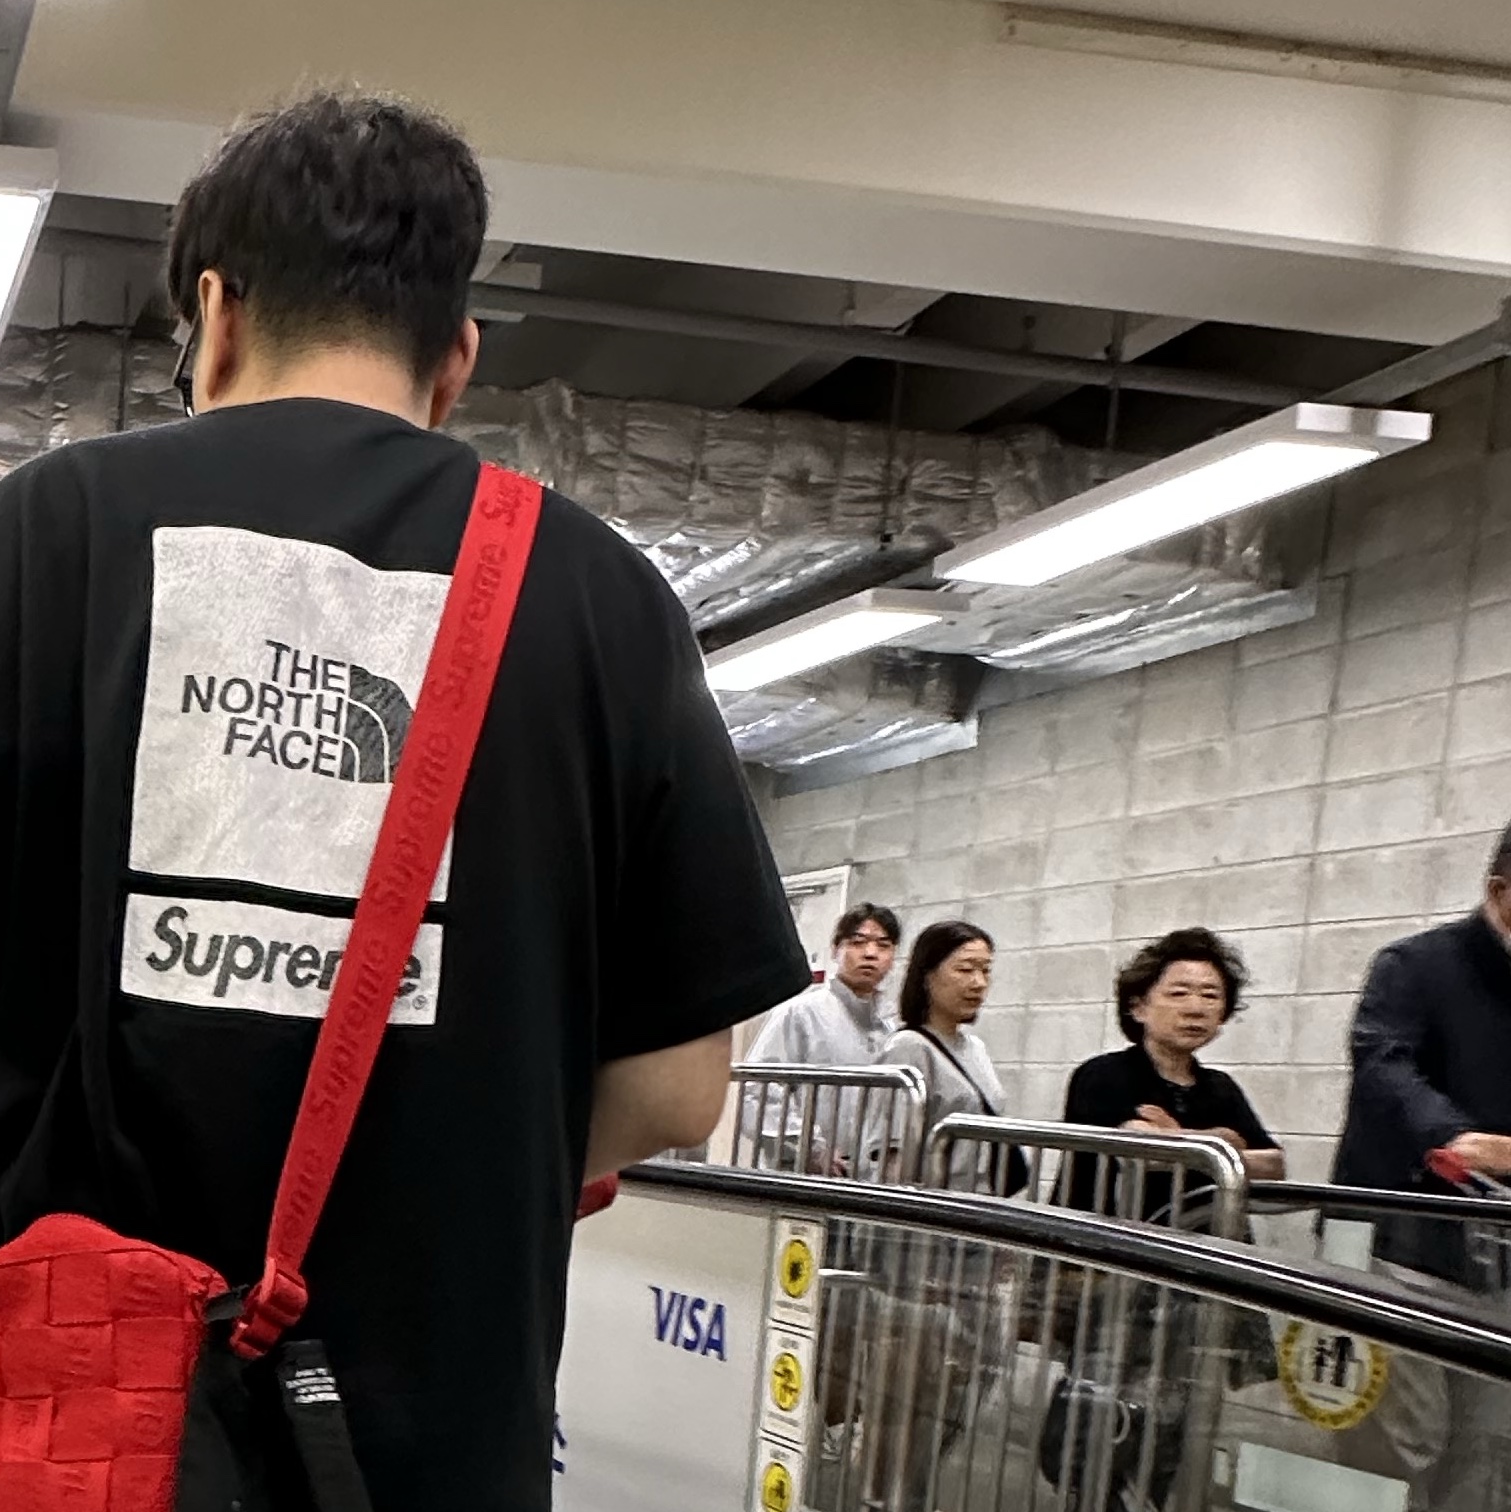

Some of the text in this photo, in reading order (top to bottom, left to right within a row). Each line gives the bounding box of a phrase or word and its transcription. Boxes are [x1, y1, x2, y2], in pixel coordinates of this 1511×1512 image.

[265, 639, 346, 694] THE
[181, 674, 344, 734] NORTH
[223, 716, 341, 778] FACE
[648, 1285, 727, 1362] VISA
